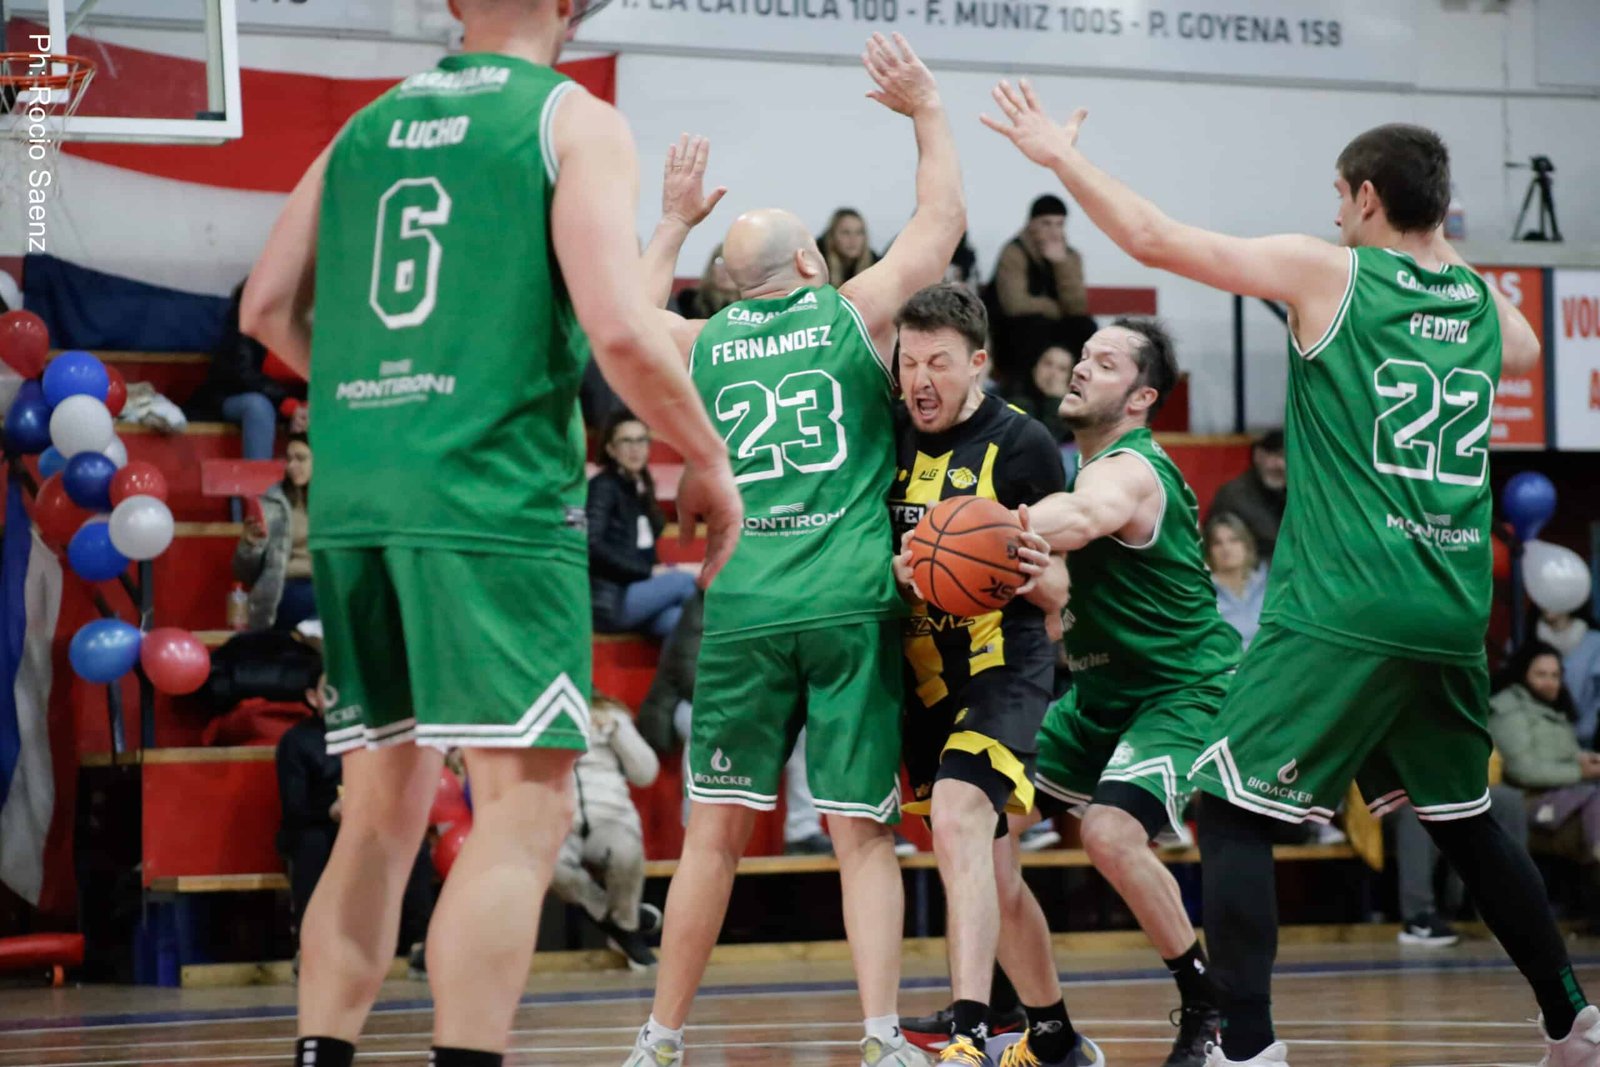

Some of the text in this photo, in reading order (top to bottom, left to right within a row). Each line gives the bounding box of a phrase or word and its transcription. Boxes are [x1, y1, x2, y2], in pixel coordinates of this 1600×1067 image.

[851, 0, 898, 22] 100
[925, 0, 947, 25] F.
[1149, 11, 1169, 38] P.
[1178, 12, 1291, 43] GOYENA
[1298, 19, 1342, 47] 158
[387, 114, 471, 149] LUCHO
[369, 176, 452, 329] 6
[711, 325, 832, 366] FERNANDEZ
[1410, 312, 1470, 344] PEDRO
[714, 369, 848, 485] 23
[1373, 358, 1495, 487] 22
